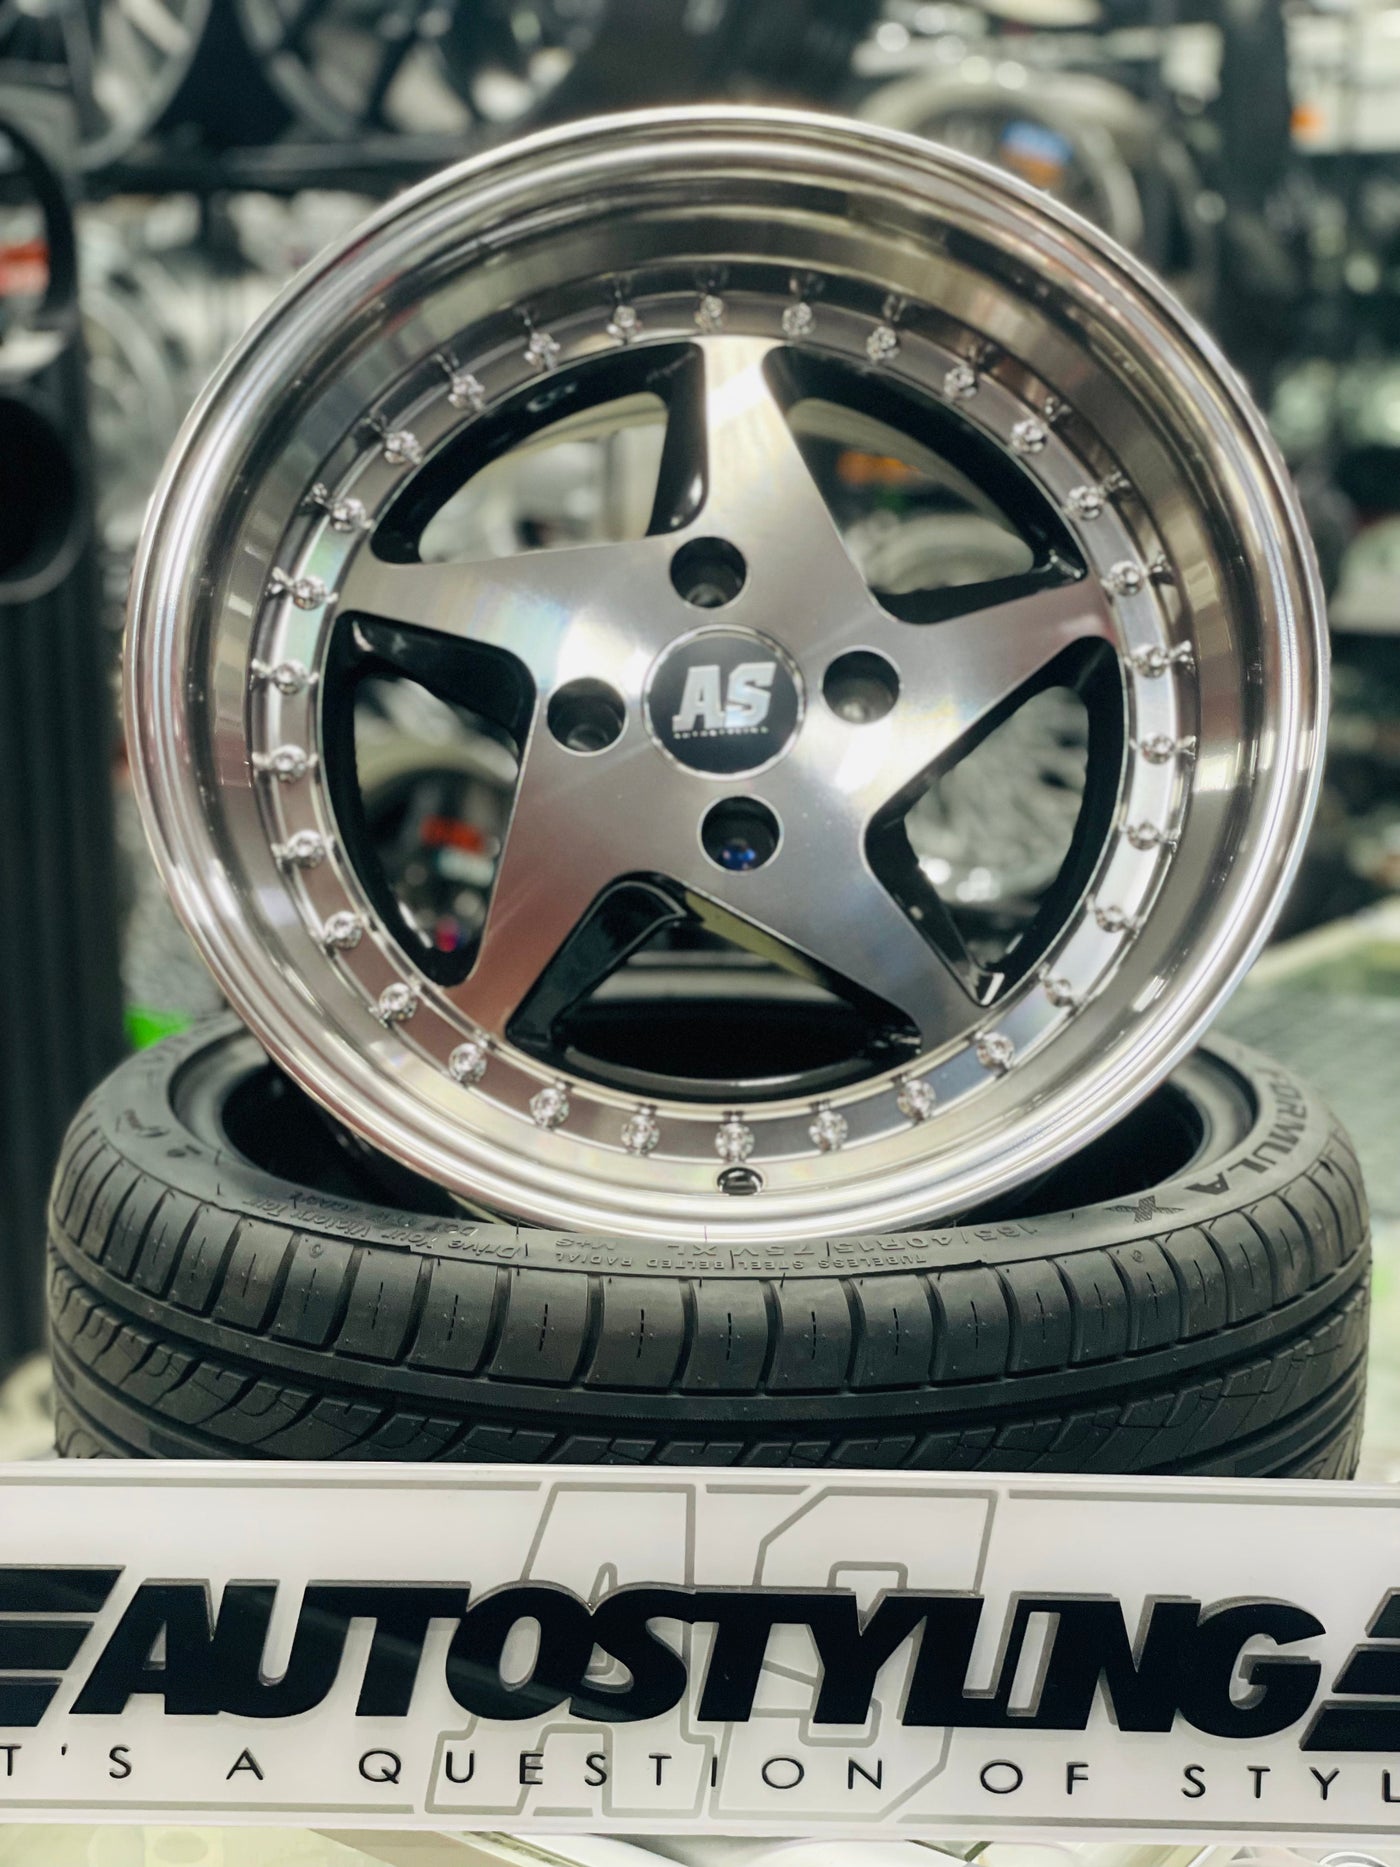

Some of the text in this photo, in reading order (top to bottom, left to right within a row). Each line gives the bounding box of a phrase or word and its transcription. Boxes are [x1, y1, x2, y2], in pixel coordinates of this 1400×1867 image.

[672, 661, 776, 732] AS
[1182, 1065, 1308, 1196] FORMULA
[381, 1228, 439, 1250] Your
[447, 1239, 521, 1260] Drive
[667, 1244, 718, 1257] XL
[555, 1252, 927, 1271] TUBELESS STEEL BELTED RADIAL
[68, 1577, 1327, 1740] AUTOSTYLING
[226, 1748, 265, 1782] A
[358, 1748, 883, 1791] QUESTION
[979, 1760, 1090, 1796] OF
